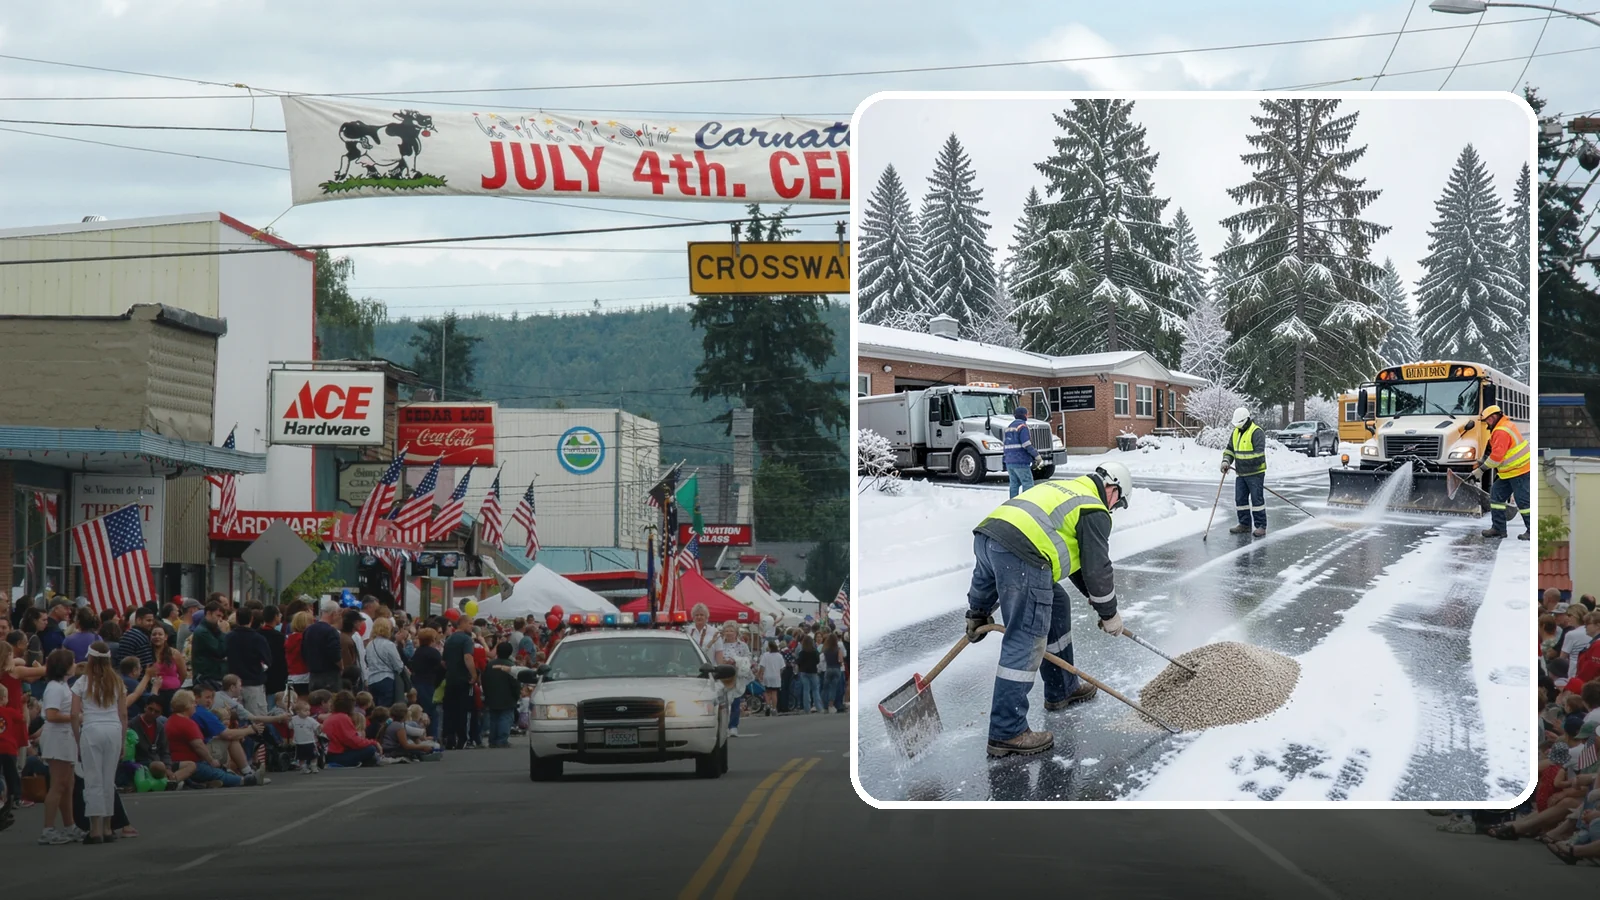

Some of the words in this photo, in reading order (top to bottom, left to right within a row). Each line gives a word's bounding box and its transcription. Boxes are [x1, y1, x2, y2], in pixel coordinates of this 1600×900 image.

[695, 121, 850, 149] Carnat
[481, 141, 604, 192] JULY
[632, 150, 746, 198] 4th.
[697, 254, 850, 280] CROSSWA
[282, 380, 373, 420] ACE
[406, 409, 452, 421] CEDAR
[461, 409, 485, 421] LOG
[283, 421, 371, 436] Hardware
[96, 485, 124, 494] Vincent
[126, 486, 136, 495] de
[138, 486, 155, 495] Paul
[688, 526, 741, 535] CRNATION
[699, 535, 730, 543] GLASS
